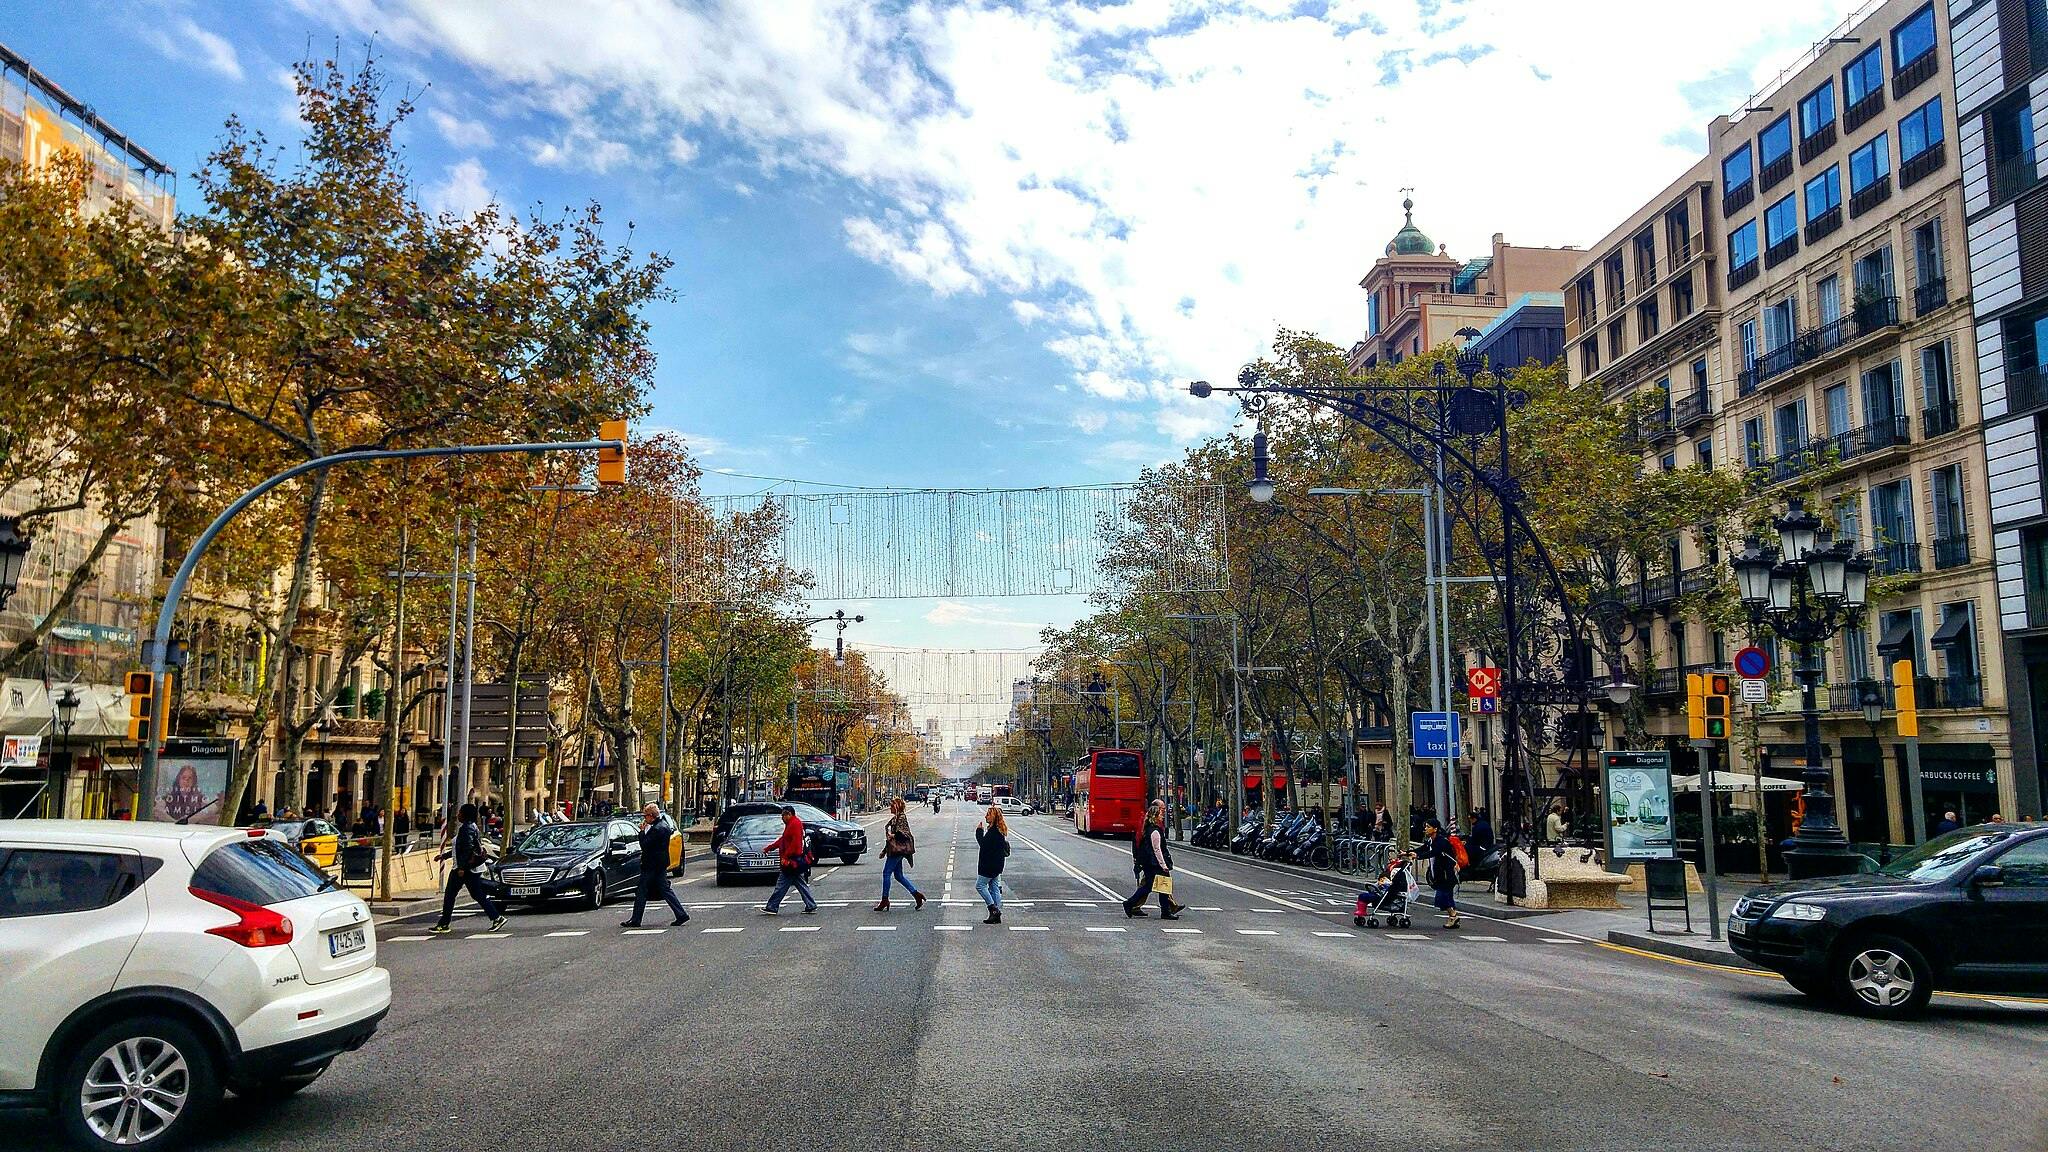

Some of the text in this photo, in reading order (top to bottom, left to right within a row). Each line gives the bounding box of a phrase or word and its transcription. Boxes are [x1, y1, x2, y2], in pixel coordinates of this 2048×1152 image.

[1475, 675, 1484, 684] M
[191, 745, 226, 754] Diagonal
[1428, 741, 1446, 750] taxi
[1920, 771, 1980, 780] ARBUCKS COFFEE
[272, 974, 299, 987] JUKE
